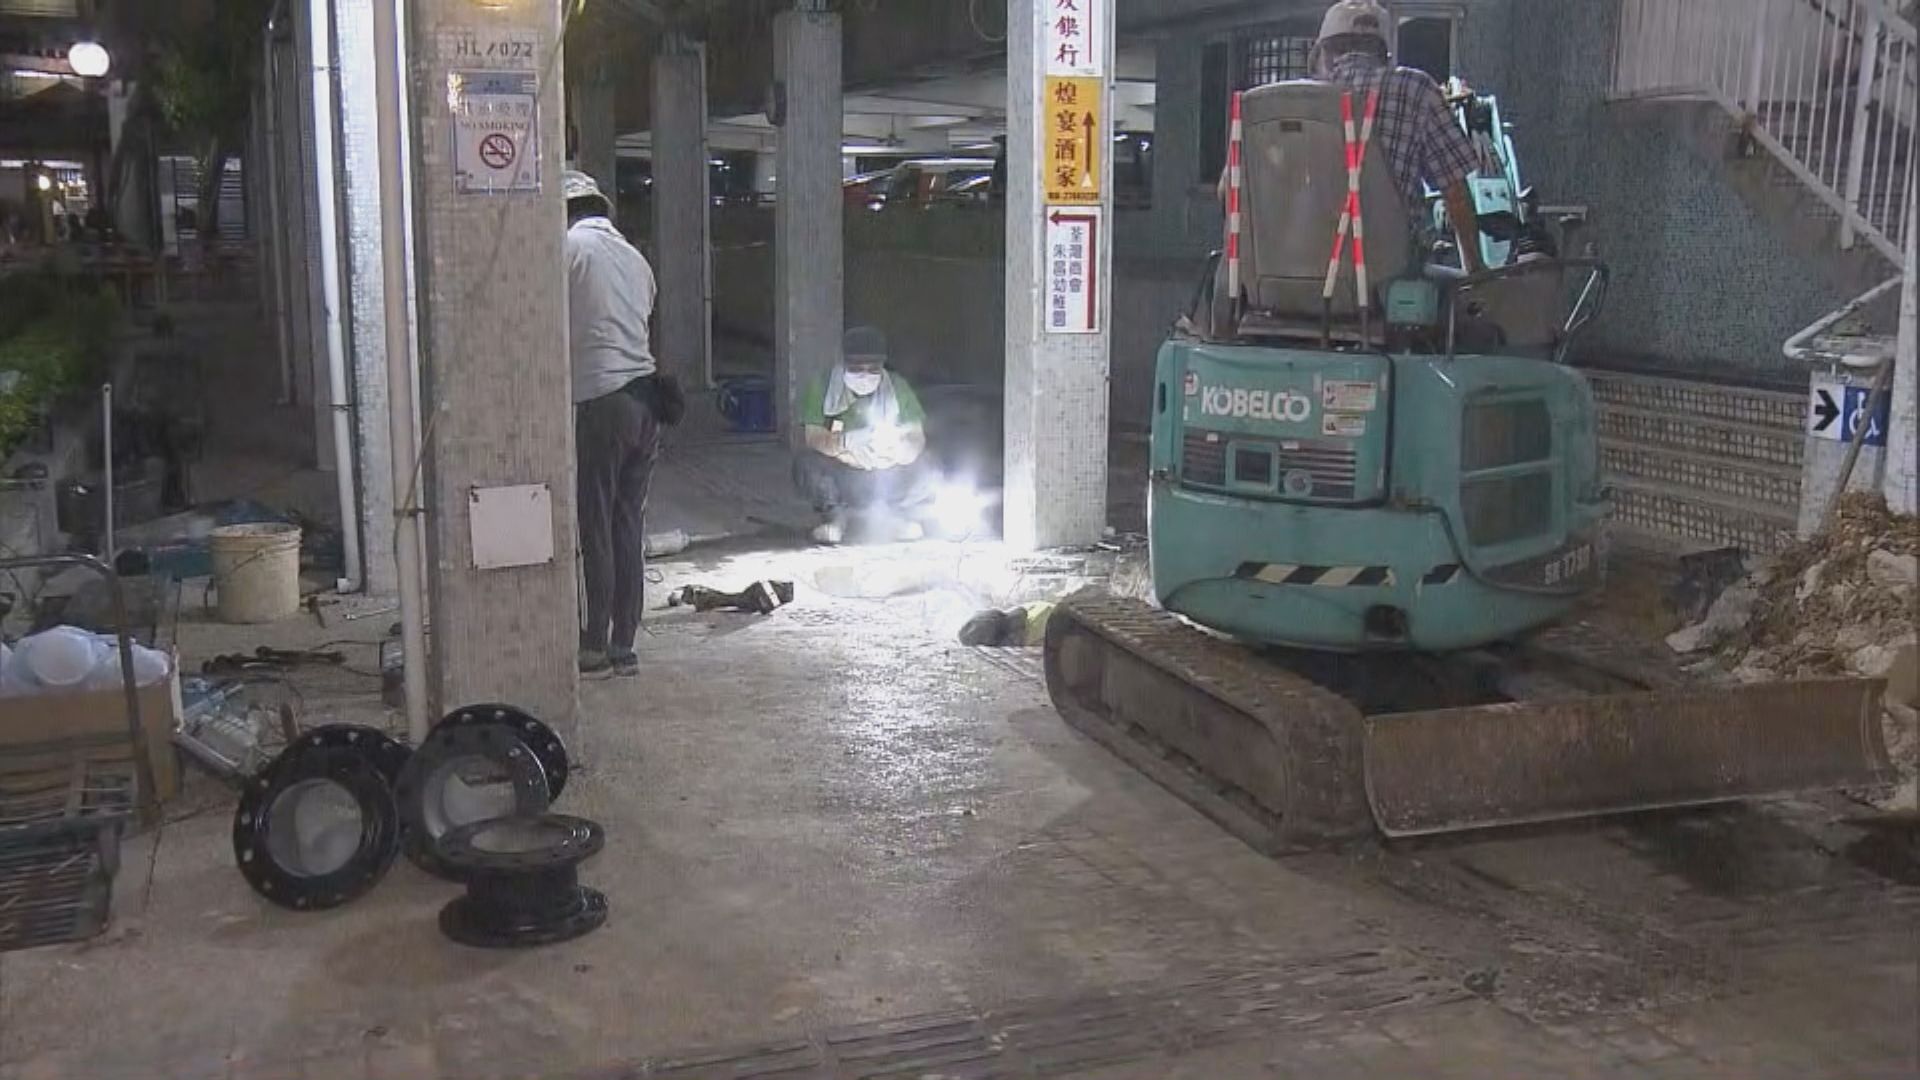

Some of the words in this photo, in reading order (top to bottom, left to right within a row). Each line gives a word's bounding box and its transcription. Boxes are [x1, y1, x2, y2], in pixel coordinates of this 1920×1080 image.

[1055, 82, 1077, 187] 煌宴酒家
[1201, 385, 1311, 422] KOBELCO
